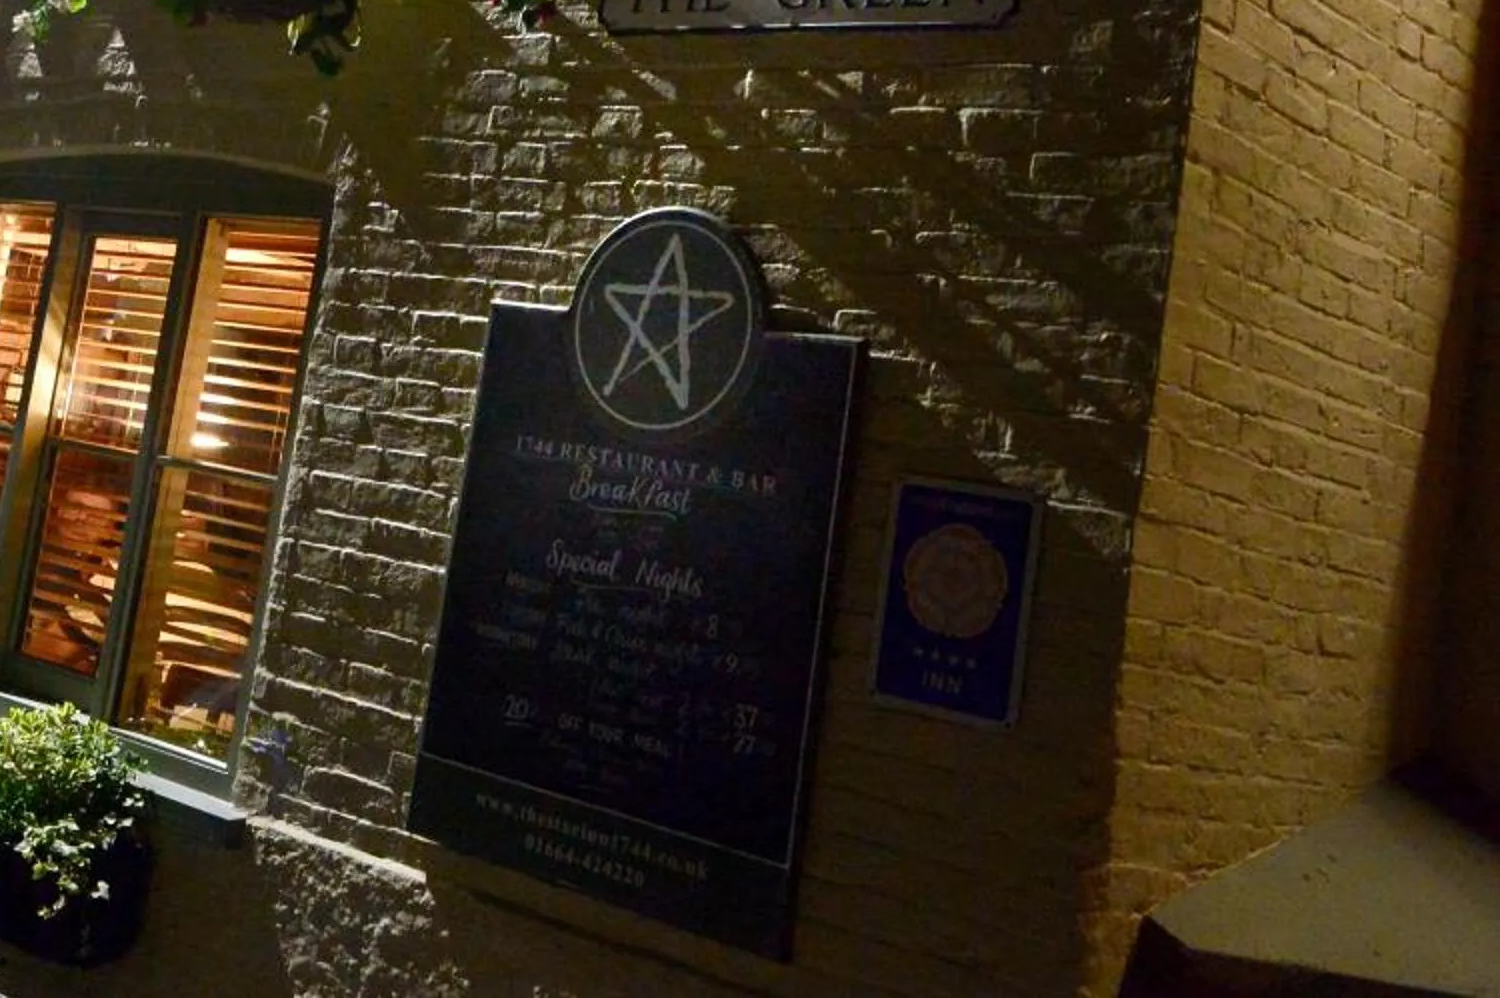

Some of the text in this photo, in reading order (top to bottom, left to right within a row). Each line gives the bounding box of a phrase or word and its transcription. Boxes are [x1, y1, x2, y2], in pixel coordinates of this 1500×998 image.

[560, 440, 700, 482] RESTAURANT
[706, 466, 726, 486] &
[731, 469, 779, 497] BAR
[545, 538, 623, 582] Special
[634, 556, 706, 604] Nights
[921, 670, 964, 695] INN
